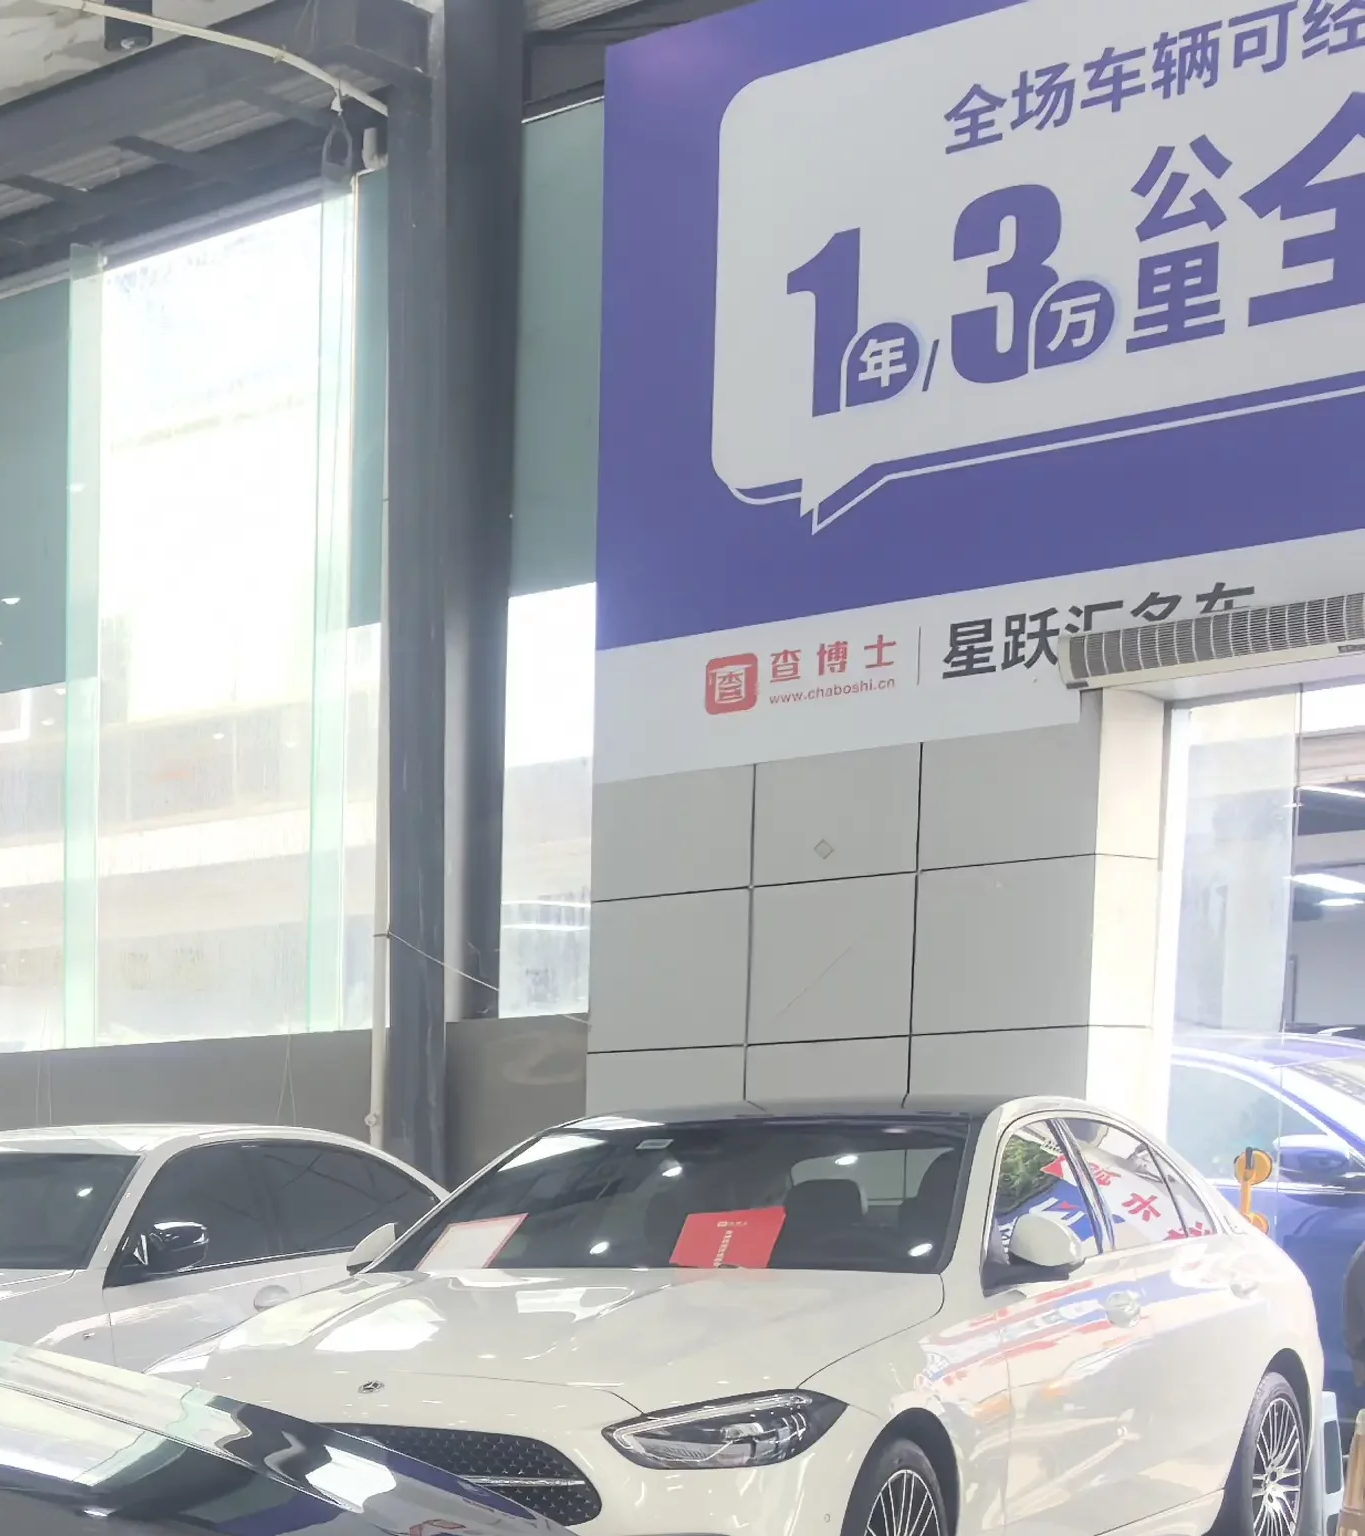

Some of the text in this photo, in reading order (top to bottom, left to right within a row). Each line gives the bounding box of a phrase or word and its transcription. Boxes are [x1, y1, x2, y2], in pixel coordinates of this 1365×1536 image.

[944, 0, 1365, 155] 全场车辆可经
[770, 635, 896, 684] 查博士
[770, 678, 895, 705] www.chaboshi.cn
